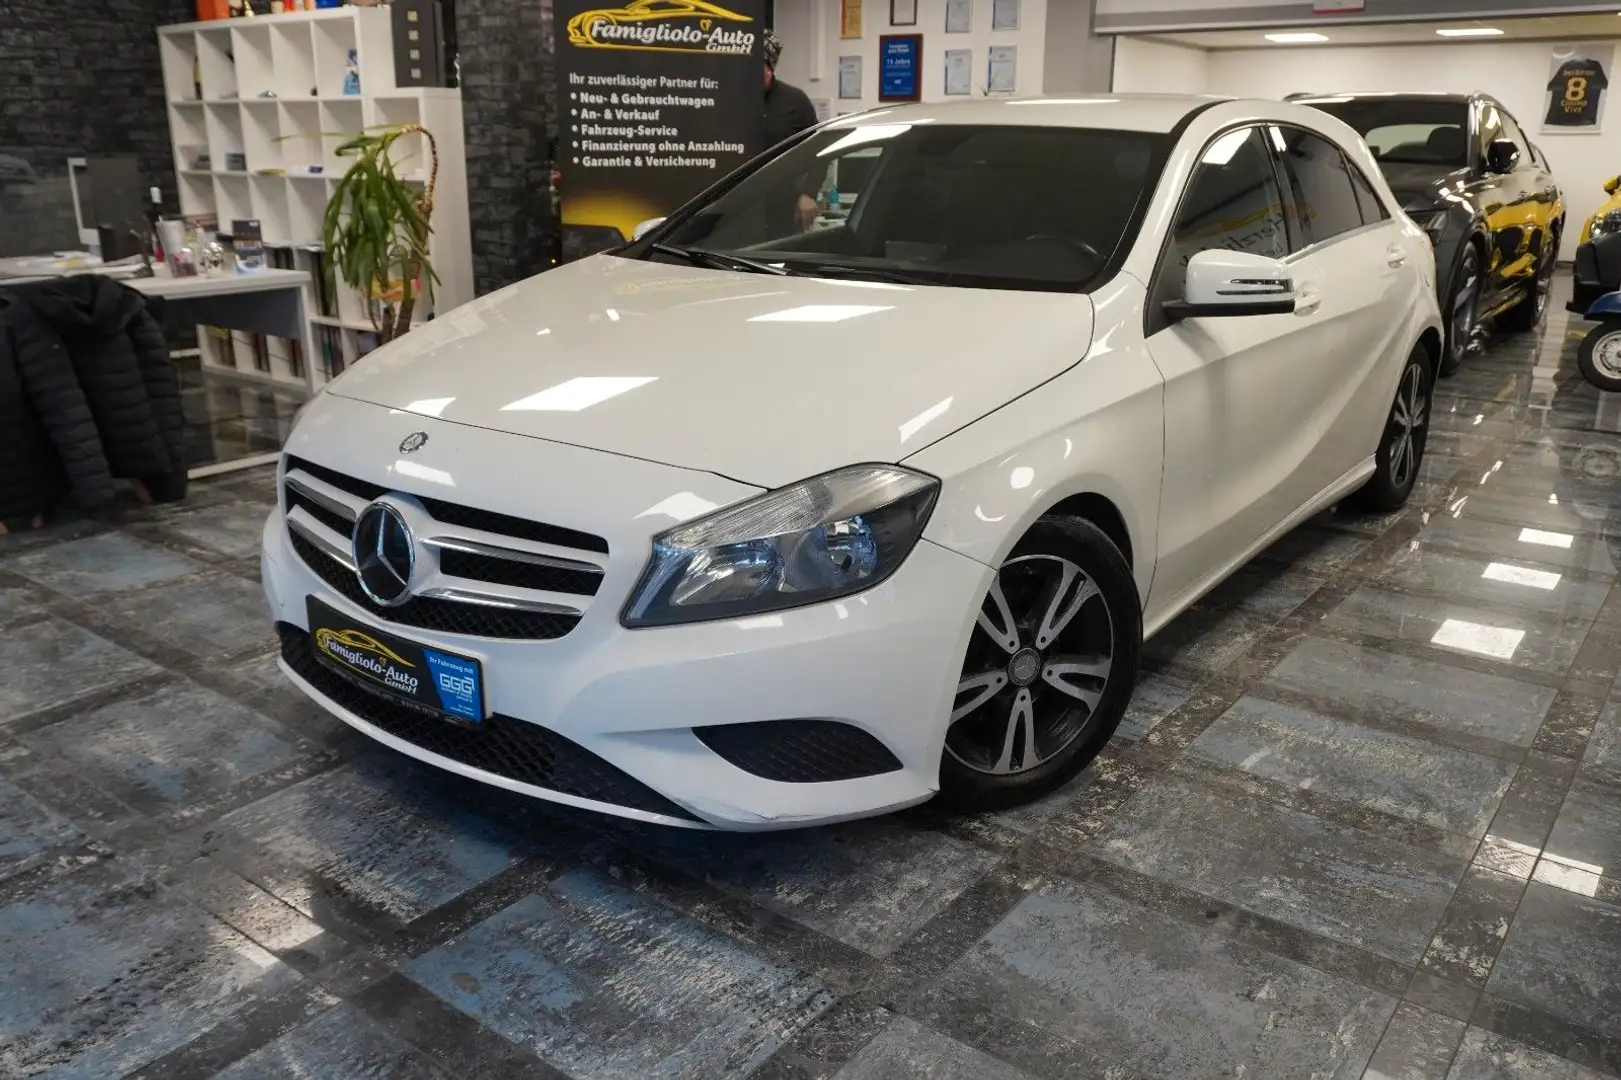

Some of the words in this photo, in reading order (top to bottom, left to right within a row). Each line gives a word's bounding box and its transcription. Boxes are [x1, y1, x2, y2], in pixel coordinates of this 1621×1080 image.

[569, 72, 585, 84] Ihr
[588, 73, 657, 89] zuverlässiger
[659, 76, 697, 88] Partner
[700, 77, 719, 89] für:
[1565, 77, 1587, 101] 8
[580, 92, 608, 104] Neu-
[610, 93, 619, 104] &
[621, 93, 715, 108] Gebrauchtwagen
[580, 108, 601, 119] An-
[604, 109, 613, 120] &
[615, 109, 660, 120] Verkauf
[581, 124, 678, 138] Fahrzeug-Service
[581, 140, 656, 154] Finanzierung
[659, 141, 686, 152] ohne
[688, 141, 744, 154] Anzahlung
[582, 156, 631, 167] Garantie
[634, 156, 643, 167] &
[646, 156, 716, 168] Versicherung
[437, 659, 463, 673] Fahrzeug
[384, 677, 418, 694] GmbH
[439, 672, 474, 695] GGG
